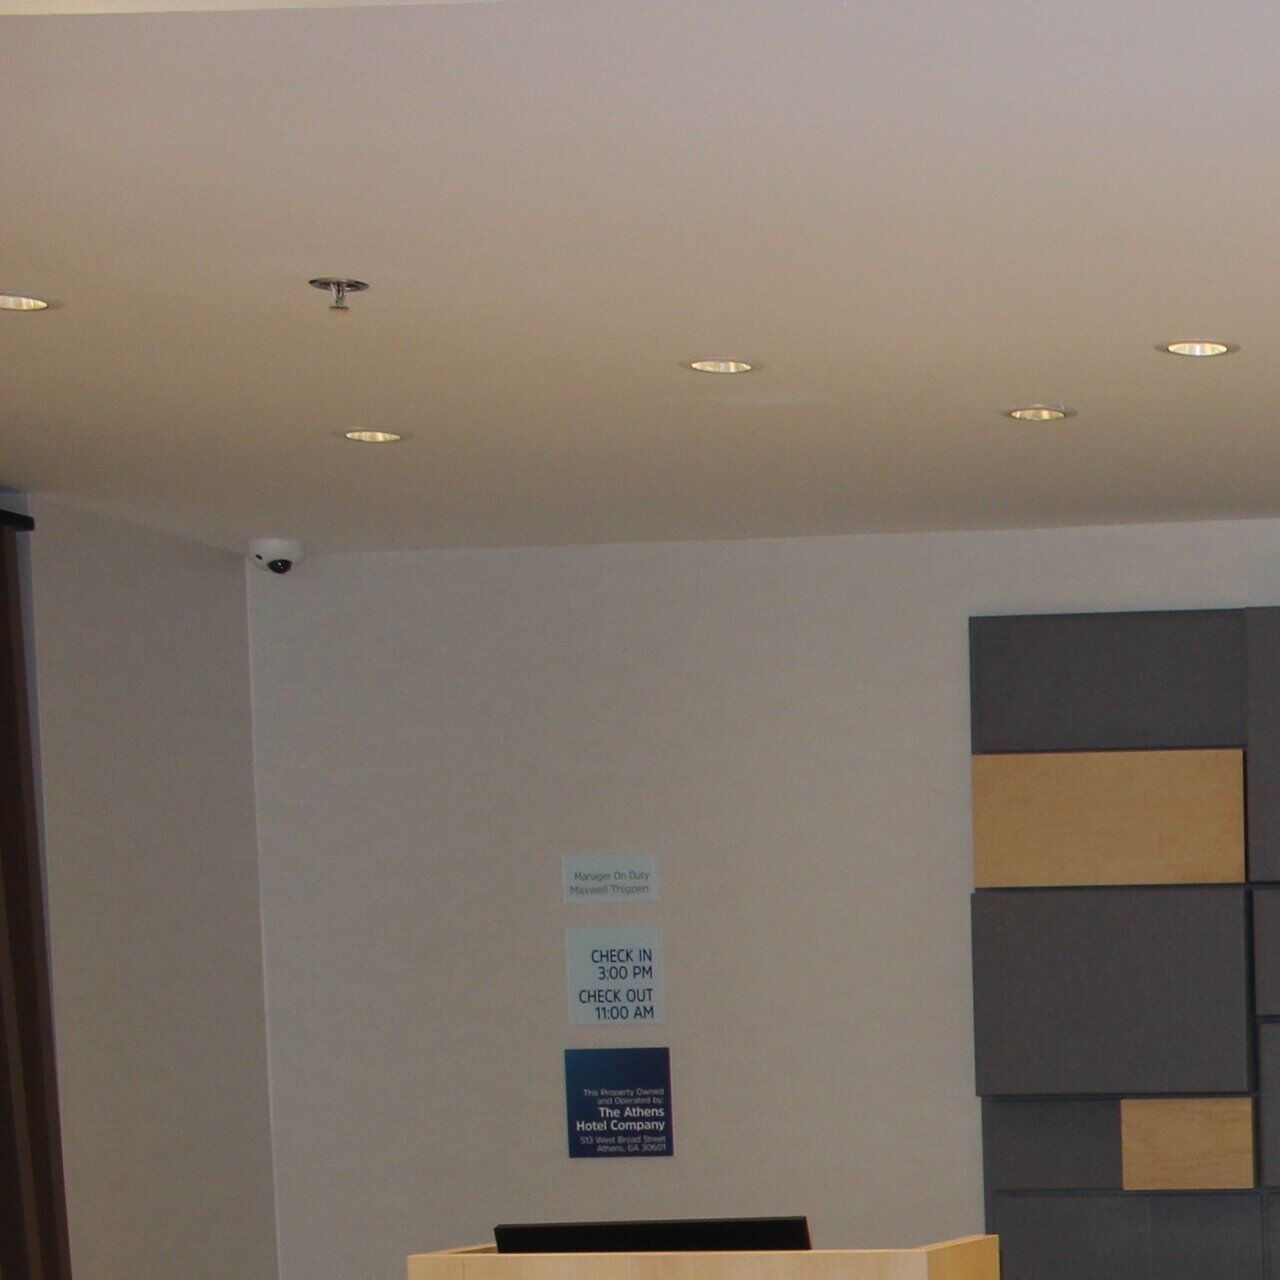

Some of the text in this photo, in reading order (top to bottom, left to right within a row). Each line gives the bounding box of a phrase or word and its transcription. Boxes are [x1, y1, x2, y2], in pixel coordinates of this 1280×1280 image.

[574, 870, 649, 882] Manager On Duty
[570, 885, 608, 895] Maxwell
[591, 949, 652, 963] CHECK IN
[598, 966, 653, 980] 3:00 PM
[579, 988, 653, 1004] CHECK OUT
[596, 1006, 654, 1020] 11:00 AM
[583, 1088, 665, 1097] This Property Owned
[599, 1107, 665, 1117] The Athens
[576, 1120, 666, 1131] Hotel Company
[580, 1134, 666, 1145] 513 West Broad Street
[627, 1144, 640, 1152] GA
[641, 1143, 667, 1152] 30601
